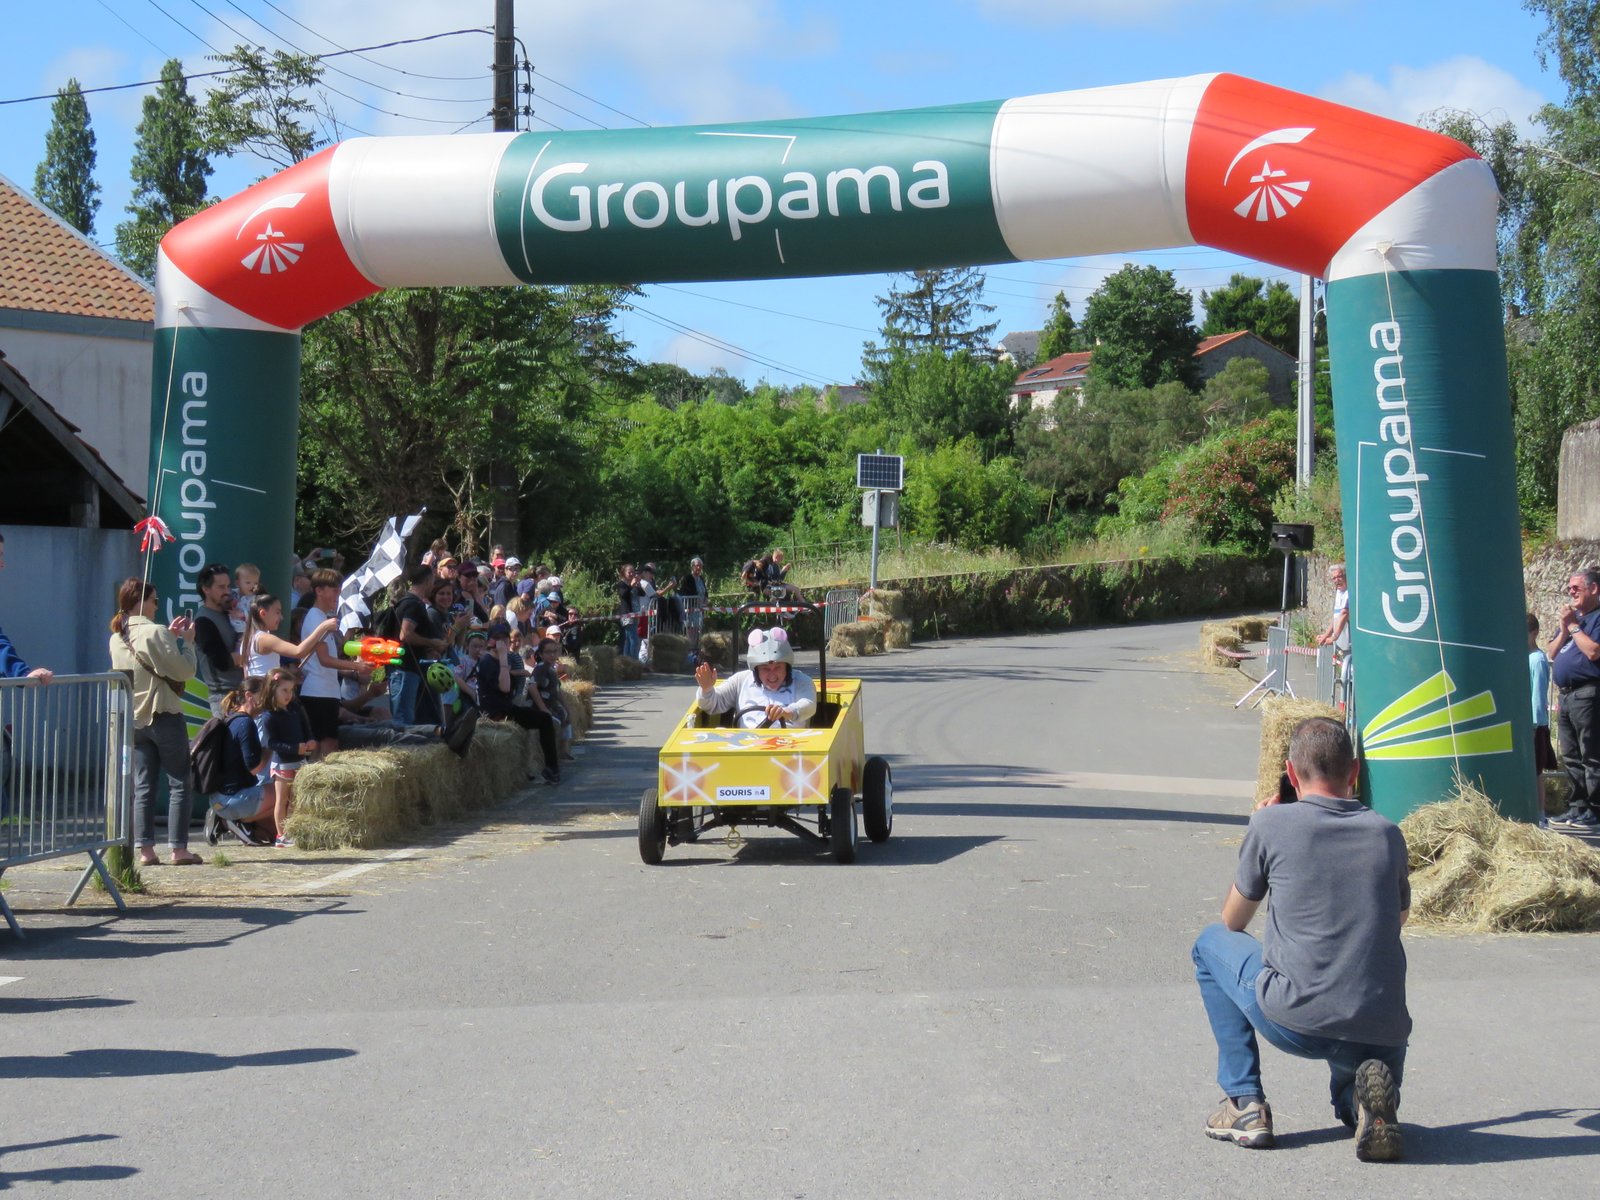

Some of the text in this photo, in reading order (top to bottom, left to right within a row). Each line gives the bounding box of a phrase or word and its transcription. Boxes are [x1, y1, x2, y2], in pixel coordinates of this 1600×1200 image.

[529, 160, 950, 241] Groupama
[1369, 321, 1430, 633] Groupama
[719, 789, 753, 797] SOURIS
